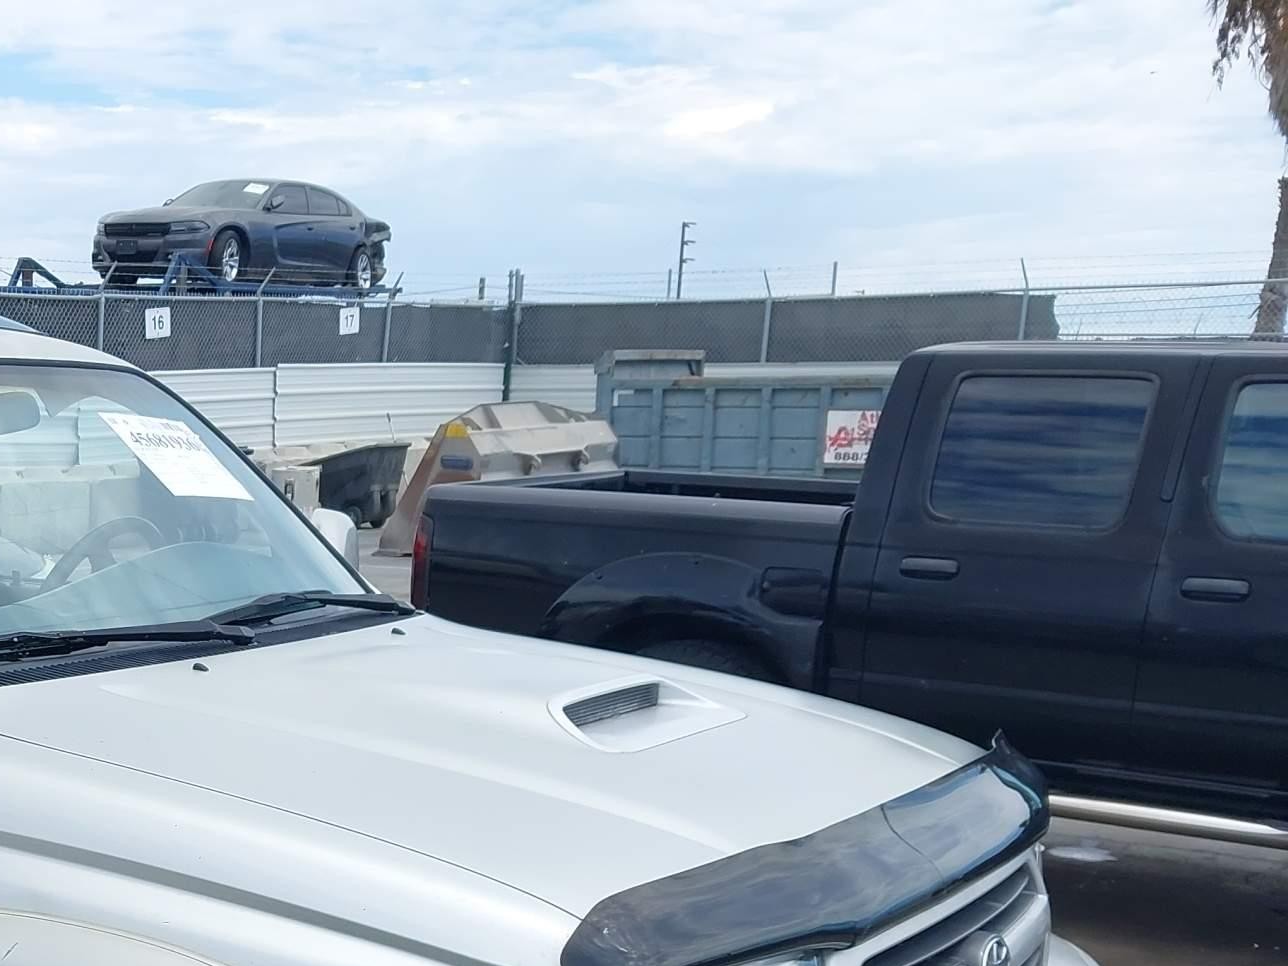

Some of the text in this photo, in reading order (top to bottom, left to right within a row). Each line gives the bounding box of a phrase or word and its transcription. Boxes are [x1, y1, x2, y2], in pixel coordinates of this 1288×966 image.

[152, 315, 164, 330] 16
[344, 314, 355, 328] 17
[129, 431, 202, 452] 45681936
